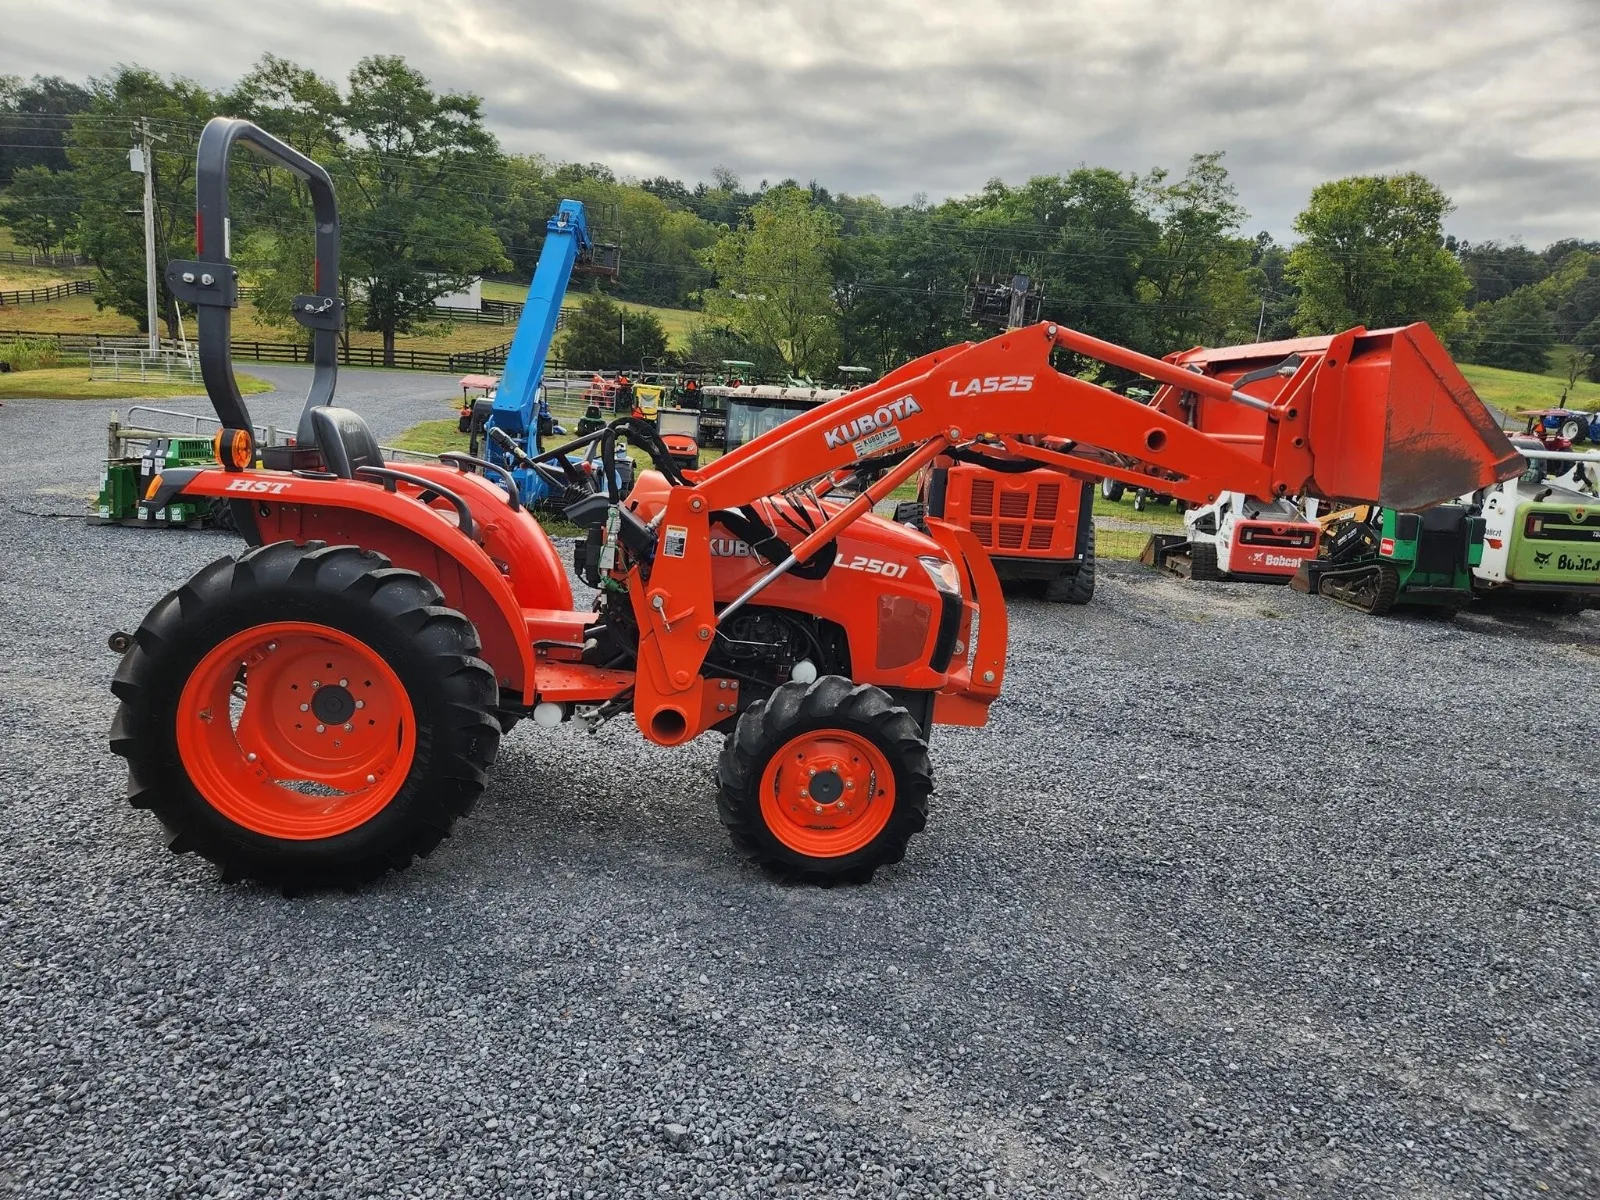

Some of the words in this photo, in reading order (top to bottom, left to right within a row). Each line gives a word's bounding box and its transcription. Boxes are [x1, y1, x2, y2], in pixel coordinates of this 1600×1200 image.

[948, 375, 1035, 397] LA525
[823, 394, 923, 450] KUBOTA
[863, 431, 889, 447] KUBOTA
[224, 479, 292, 494] HST
[1488, 498, 1498, 510] 2
[709, 538, 762, 558] KUB
[834, 553, 908, 578] L2501
[1265, 554, 1303, 568] Bobcat
[1558, 553, 1600, 571] Bobca
